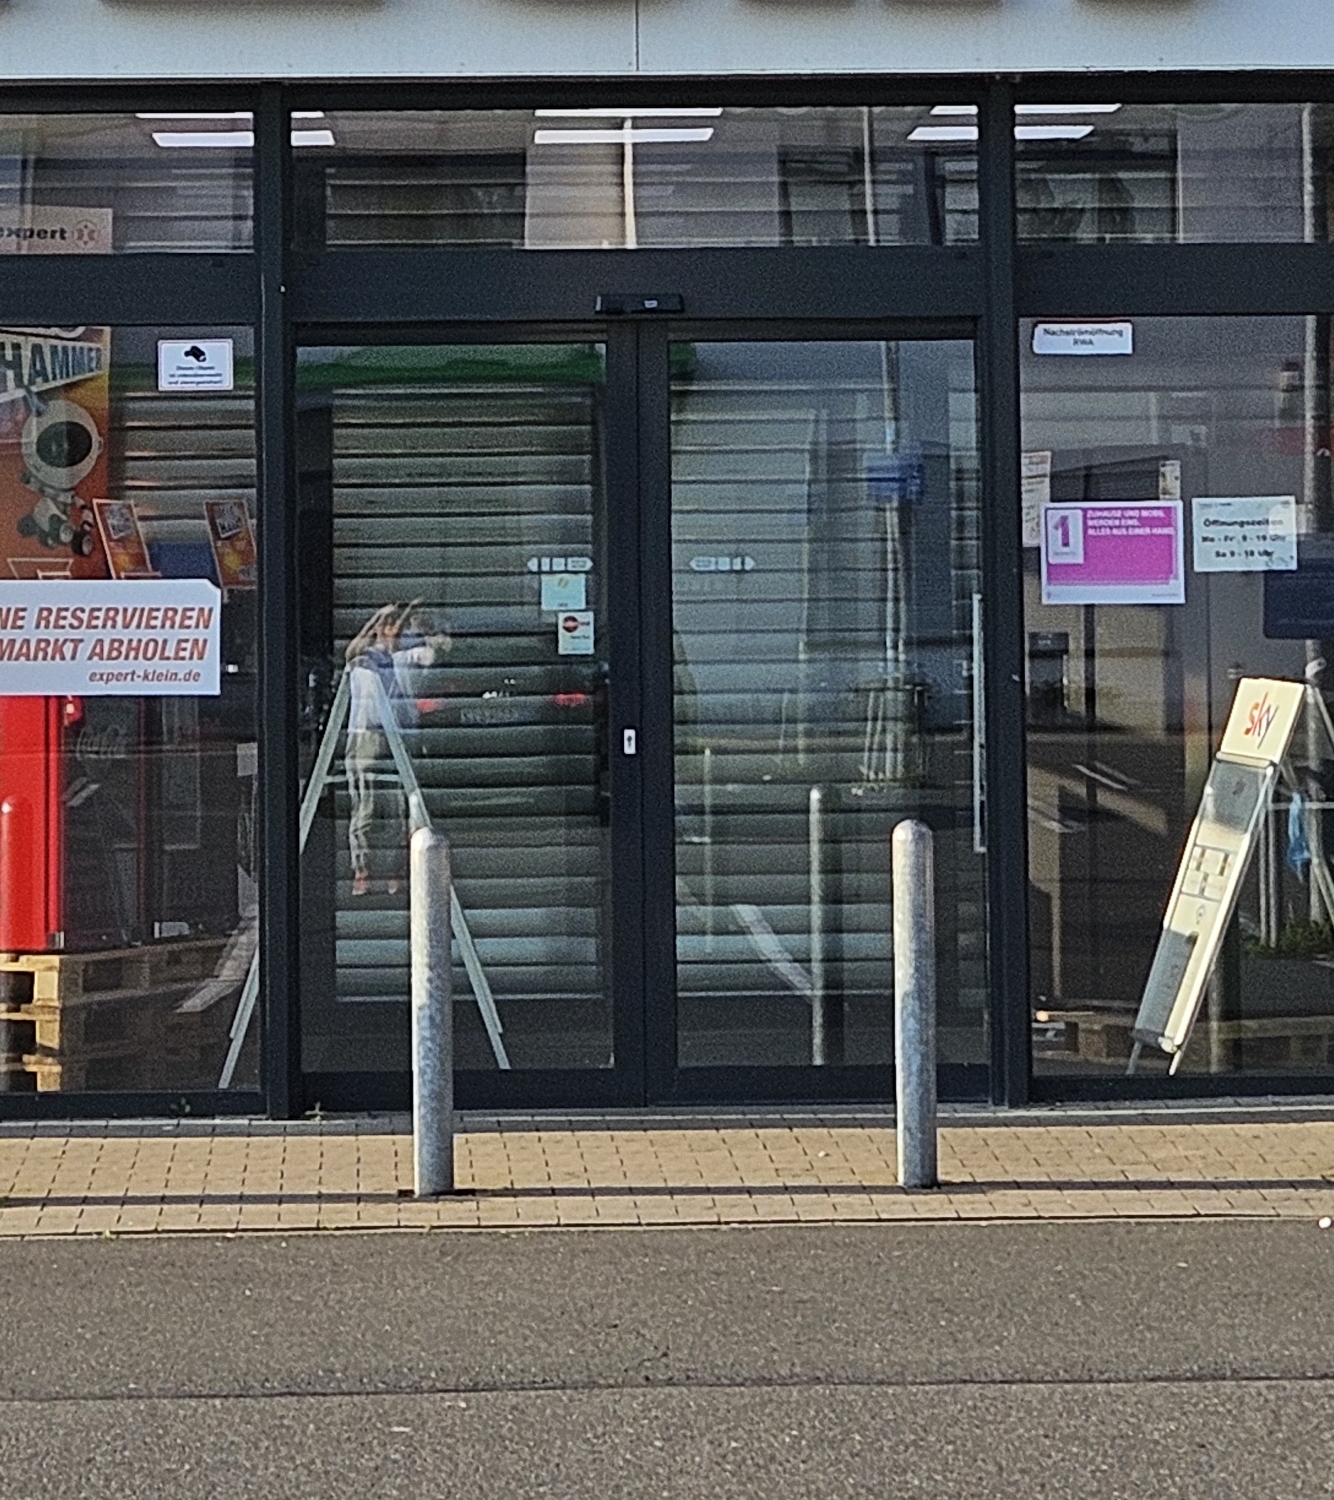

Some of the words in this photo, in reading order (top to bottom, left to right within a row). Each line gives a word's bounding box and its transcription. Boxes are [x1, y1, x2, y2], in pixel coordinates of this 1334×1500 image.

[35, 607, 212, 631] RESERVIEREN
[88, 638, 207, 661] ABHOLEN
[89, 667, 200, 684] expert-klein.de
